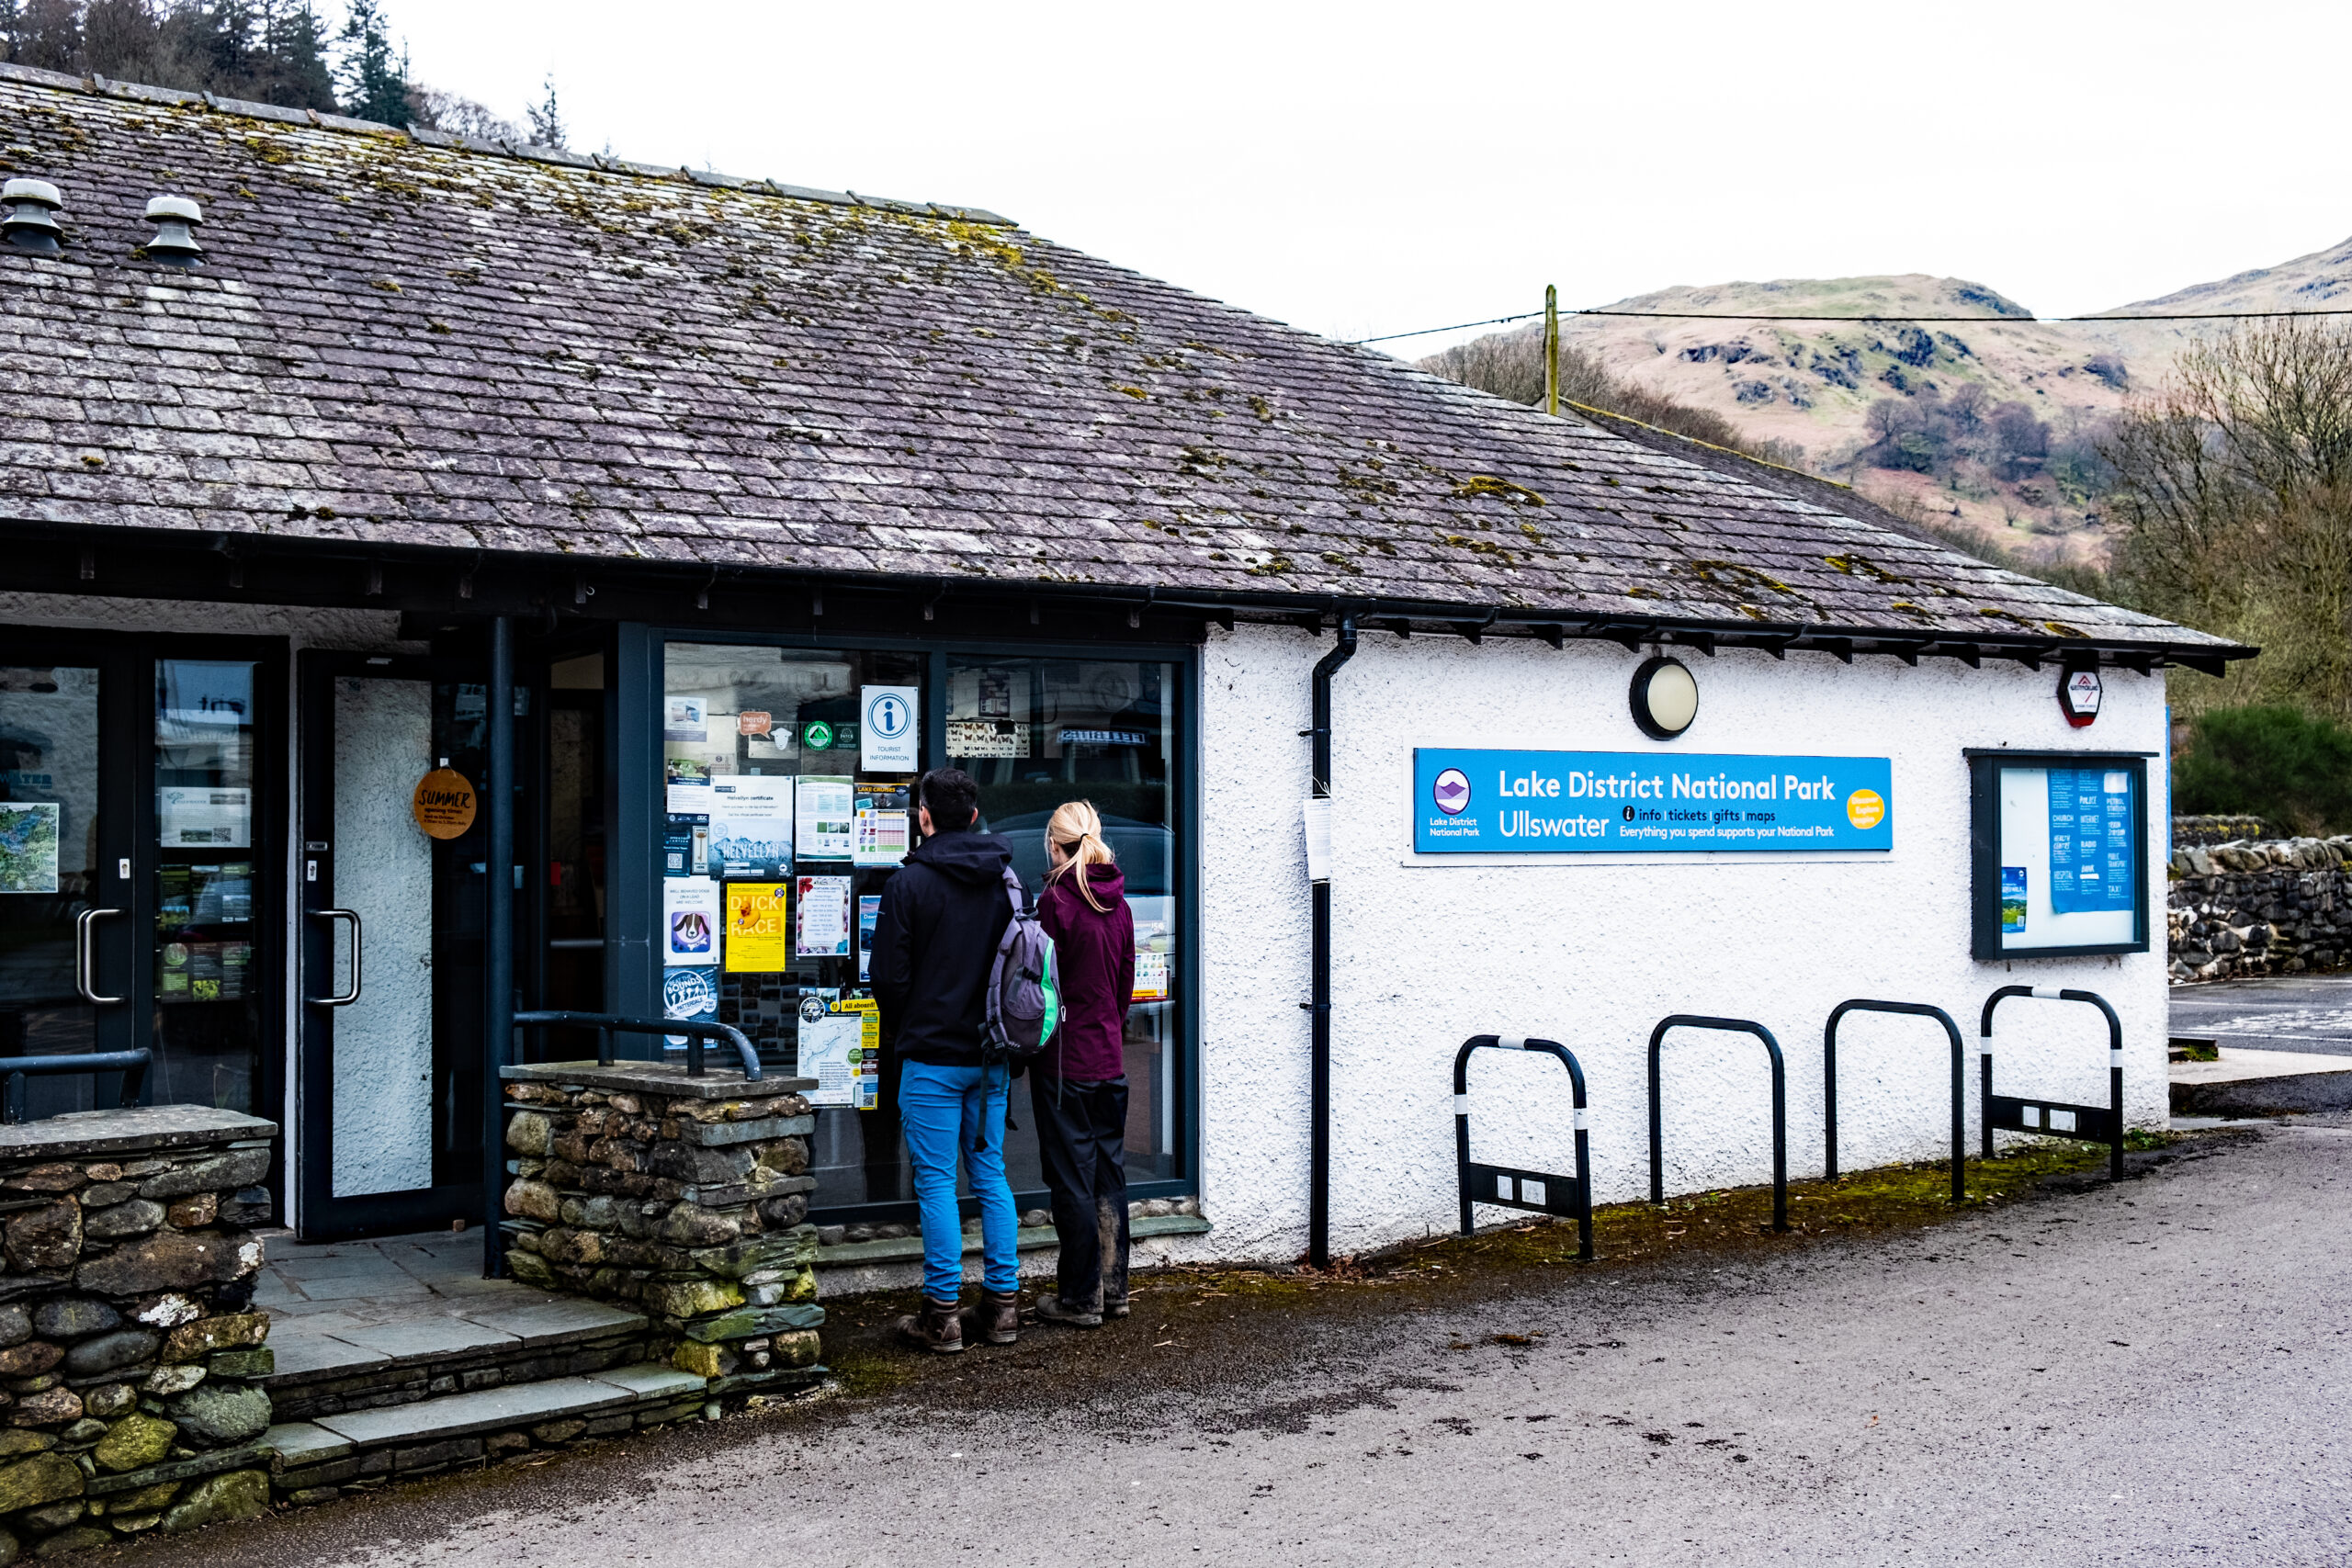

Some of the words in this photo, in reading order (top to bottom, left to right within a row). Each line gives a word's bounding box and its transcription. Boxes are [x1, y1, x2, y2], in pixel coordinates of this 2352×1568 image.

[743, 716, 767, 724] herdy
[1499, 770, 1560, 797] Lake
[1569, 771, 1664, 798] District
[1672, 773, 1777, 800] National
[1784, 775, 1836, 800] Park
[419, 790, 470, 809] SUMMER
[1430, 818, 1447, 826] Lake
[1449, 818, 1477, 826] District
[1499, 810, 1609, 837] Ullswater
[1639, 809, 1661, 821] info
[1668, 809, 1707, 821] tickets
[1714, 810, 1740, 824] gifts
[1747, 811, 1776, 824] maps
[2080, 815, 2099, 823] INTERNET
[1430, 828, 1462, 837] National
[1463, 828, 1480, 837] Park
[1620, 826, 1668, 840] Everything
[1670, 829, 1686, 840] you
[1688, 826, 1715, 840] spend
[1717, 827, 1755, 840] supports
[1757, 829, 1776, 840] your
[1778, 826, 1814, 837] National
[1815, 826, 1834, 837] Park
[723, 843, 779, 858] HELVELLYN
[730, 896, 779, 910] DUCK
[731, 919, 777, 936] RACE
[667, 976, 701, 994] BOUNDS
[677, 998, 703, 1010] PATTERDALE
